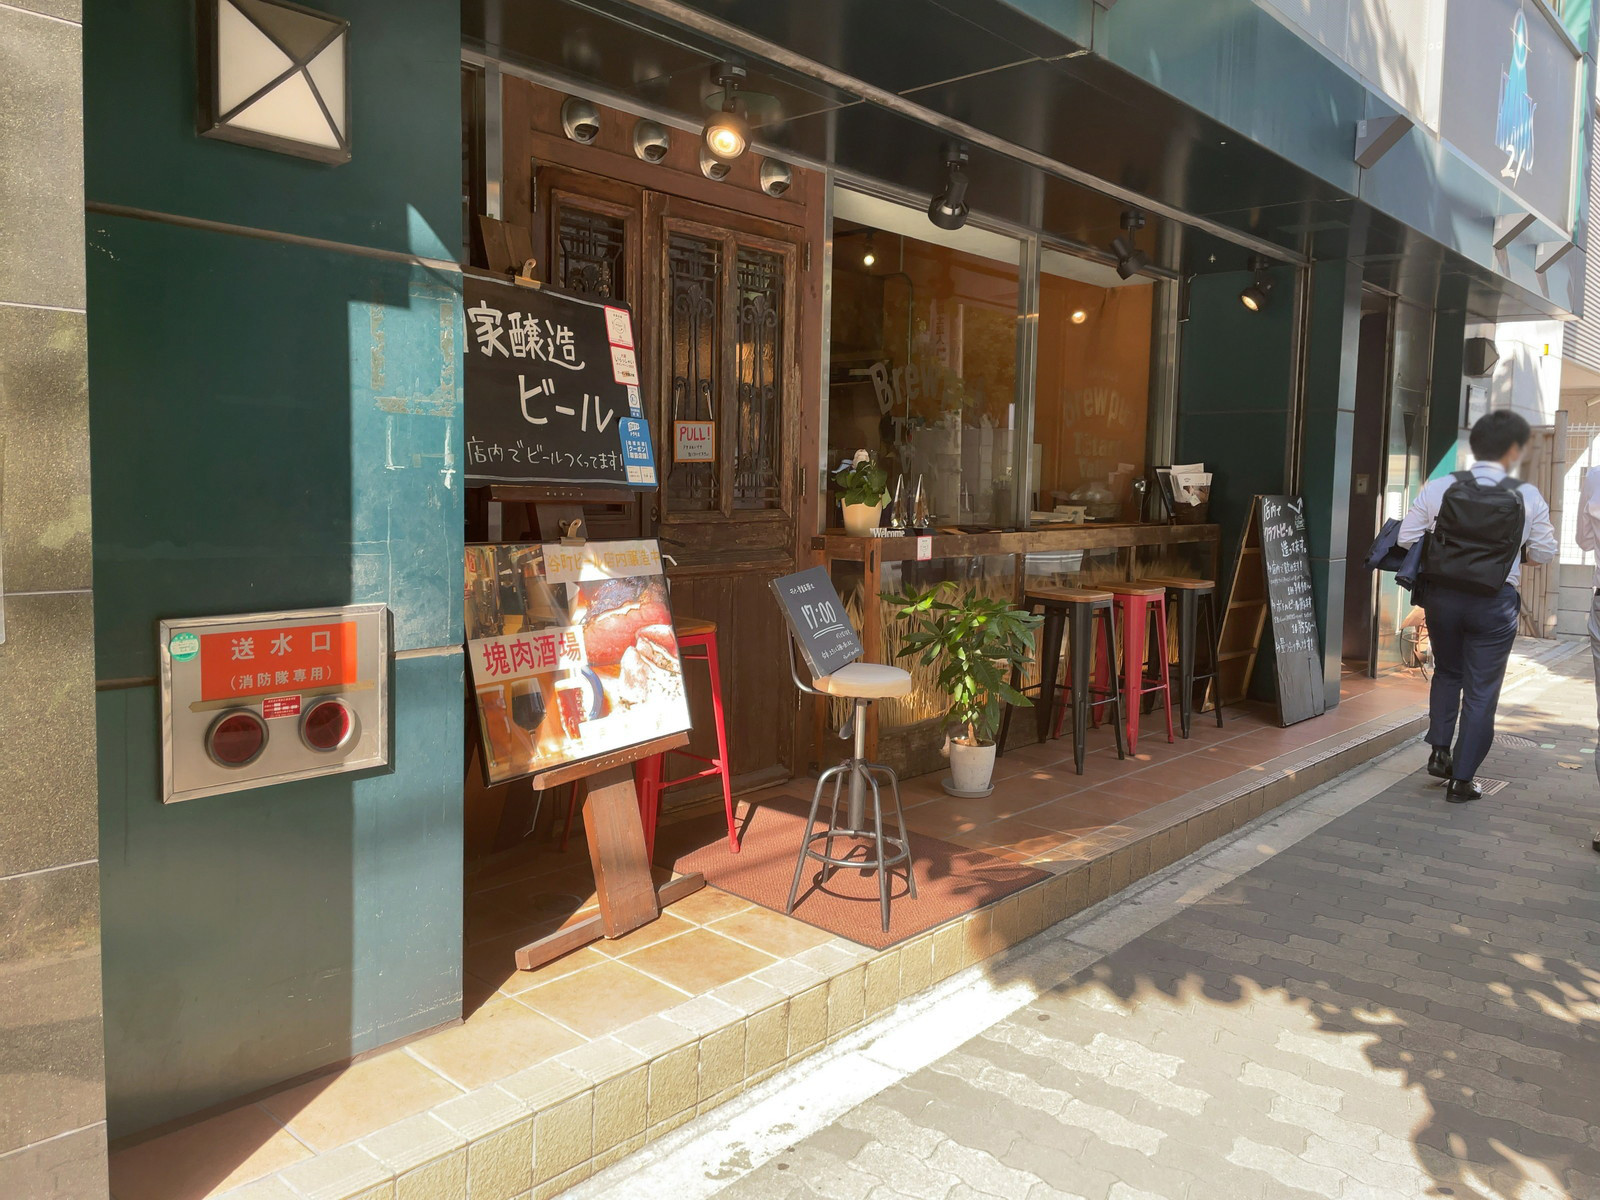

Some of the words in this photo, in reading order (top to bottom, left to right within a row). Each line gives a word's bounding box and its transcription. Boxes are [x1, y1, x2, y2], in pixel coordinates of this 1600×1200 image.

[463, 299, 586, 371] 家醸造
[518, 374, 614, 433] ビール
[872, 527, 905, 538] Welcome
[800, 600, 837, 630] 17:00
[231, 631, 331, 662] 送水口
[482, 631, 582, 677] 塊肉酒場
